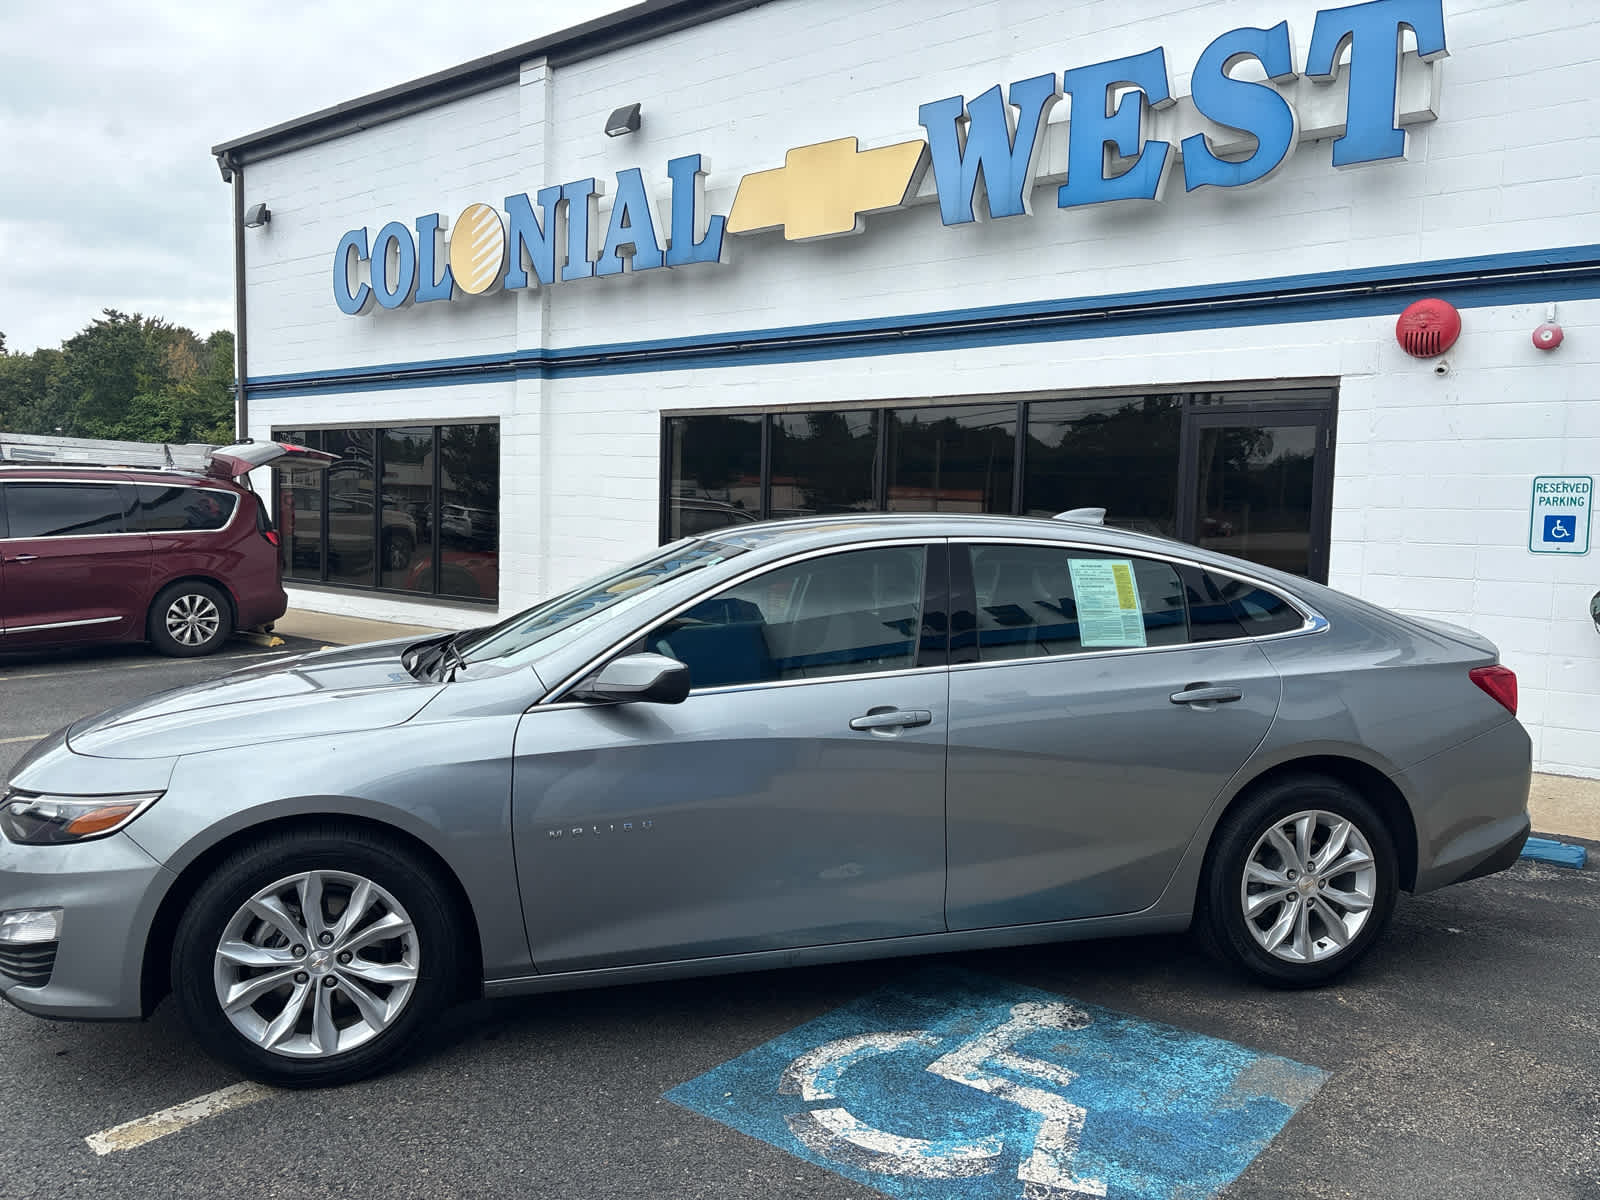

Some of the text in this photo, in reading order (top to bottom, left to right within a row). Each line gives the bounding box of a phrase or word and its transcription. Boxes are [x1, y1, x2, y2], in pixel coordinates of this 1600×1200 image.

[333, 0, 1448, 315] COLONIAL WEST
[1536, 482, 1590, 494] RESERVED
[1538, 496, 1585, 507] PARKING
